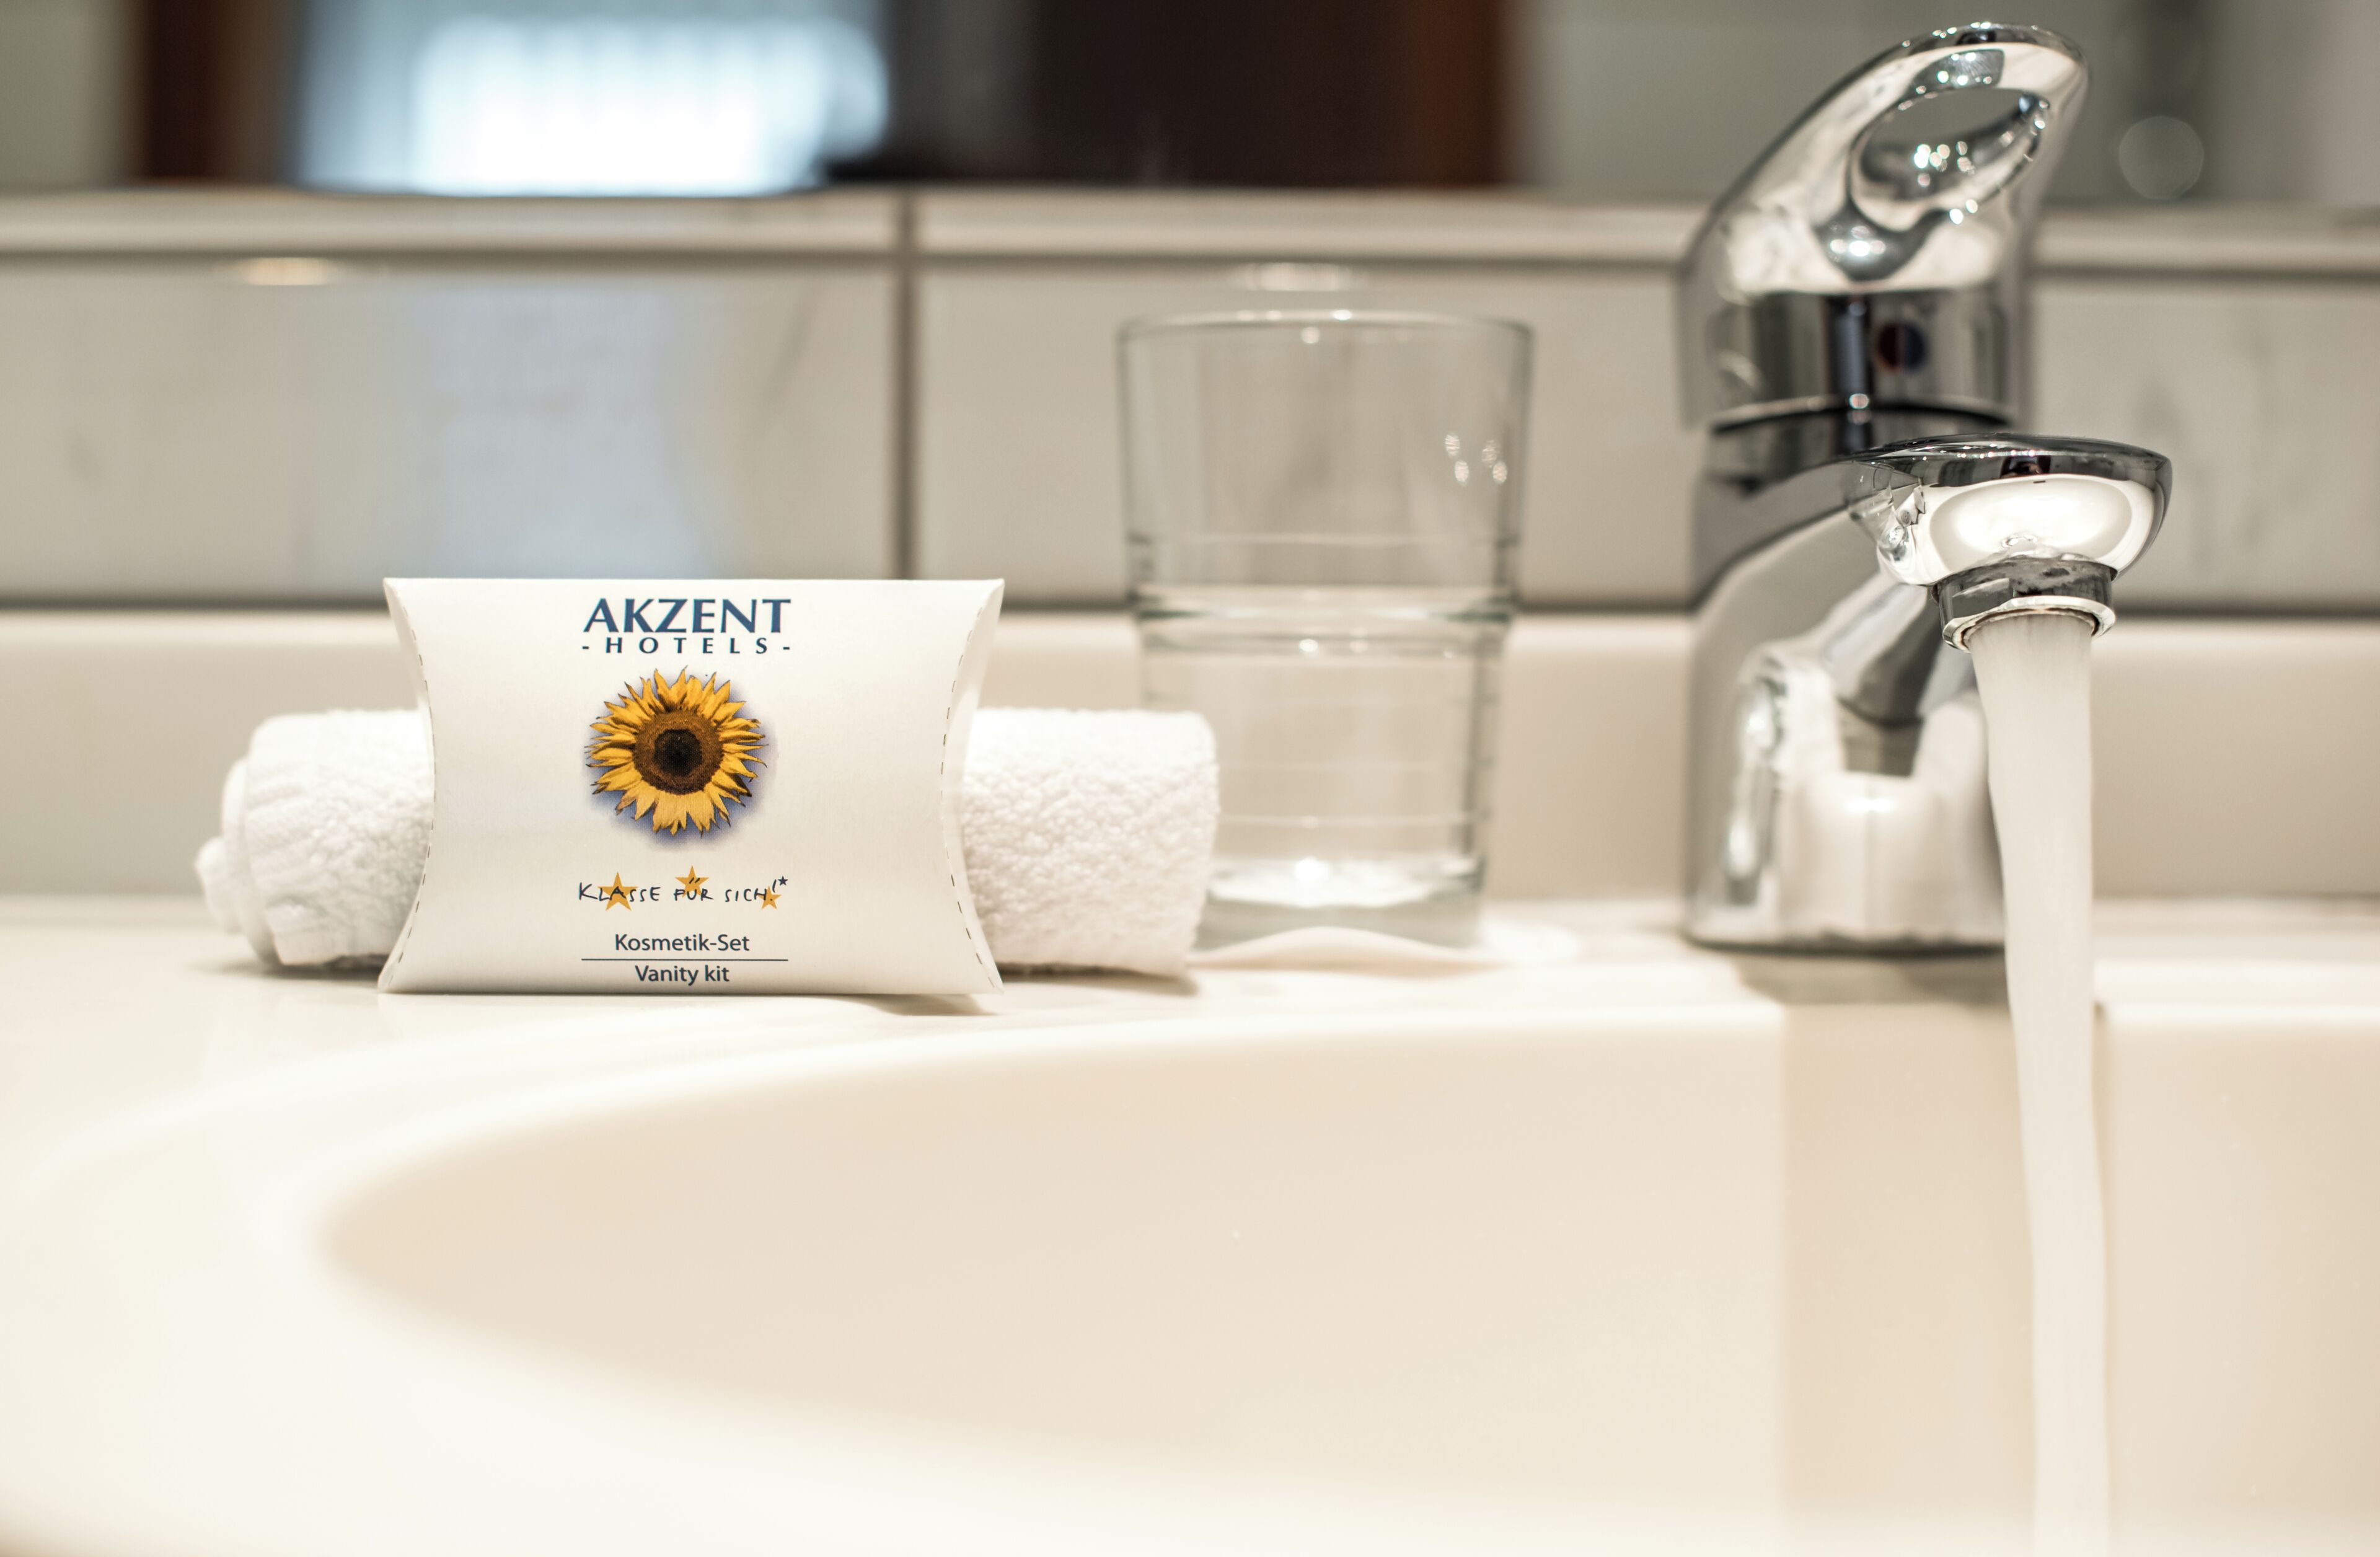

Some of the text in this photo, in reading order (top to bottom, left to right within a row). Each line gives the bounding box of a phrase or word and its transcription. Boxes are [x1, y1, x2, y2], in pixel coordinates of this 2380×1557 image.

[583, 598, 791, 633] AKZENT
[578, 882, 661, 902] KLASSE
[673, 877, 713, 902] FÜR
[615, 933, 750, 951] Kosmetik-Set
[635, 964, 730, 986] Vanity kit
